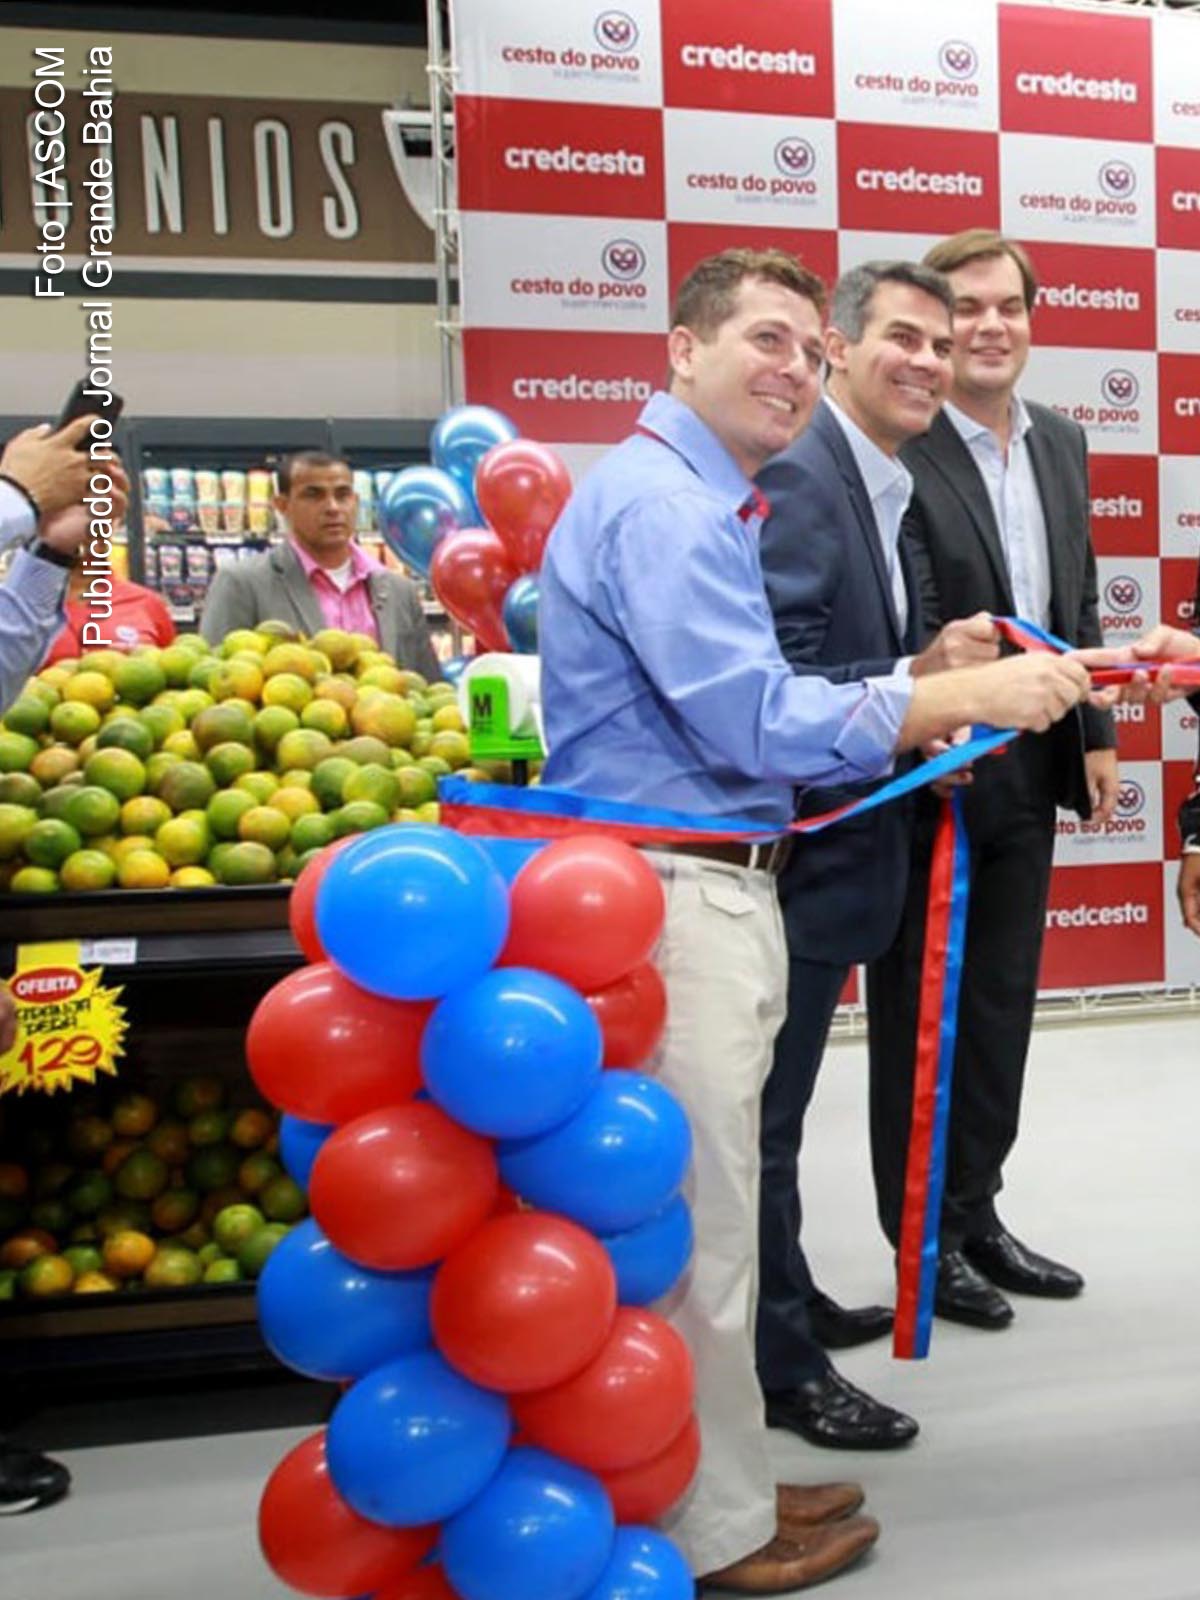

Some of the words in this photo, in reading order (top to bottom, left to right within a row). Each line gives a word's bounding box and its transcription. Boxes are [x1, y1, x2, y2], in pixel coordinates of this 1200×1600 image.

[502, 45, 556, 65] cesta
[561, 48, 586, 67] do
[591, 53, 640, 71] povo
[681, 44, 816, 76] credcesta
[855, 73, 903, 91] cesta
[908, 75, 931, 93] do
[935, 82, 979, 98] povo
[1015, 70, 1138, 103] credcesta
[504, 145, 646, 176] credcesta
[687, 172, 738, 190] cesta
[742, 173, 767, 192] do
[771, 179, 817, 196] povo
[856, 166, 983, 197] credcesta
[1019, 192, 1066, 210] cesta
[1069, 195, 1091, 212] do
[1095, 199, 1137, 216] povo
[510, 277, 564, 295] cesta
[568, 277, 594, 296] do
[599, 281, 647, 300] povo
[1035, 283, 1140, 310] redcesta
[512, 374, 652, 401] credcesta
[1073, 404, 1094, 421] do
[1099, 408, 1140, 424] povo
[1091, 495, 1143, 517] esta
[1105, 818, 1146, 835] povo
[1045, 902, 1148, 928] redcesta
